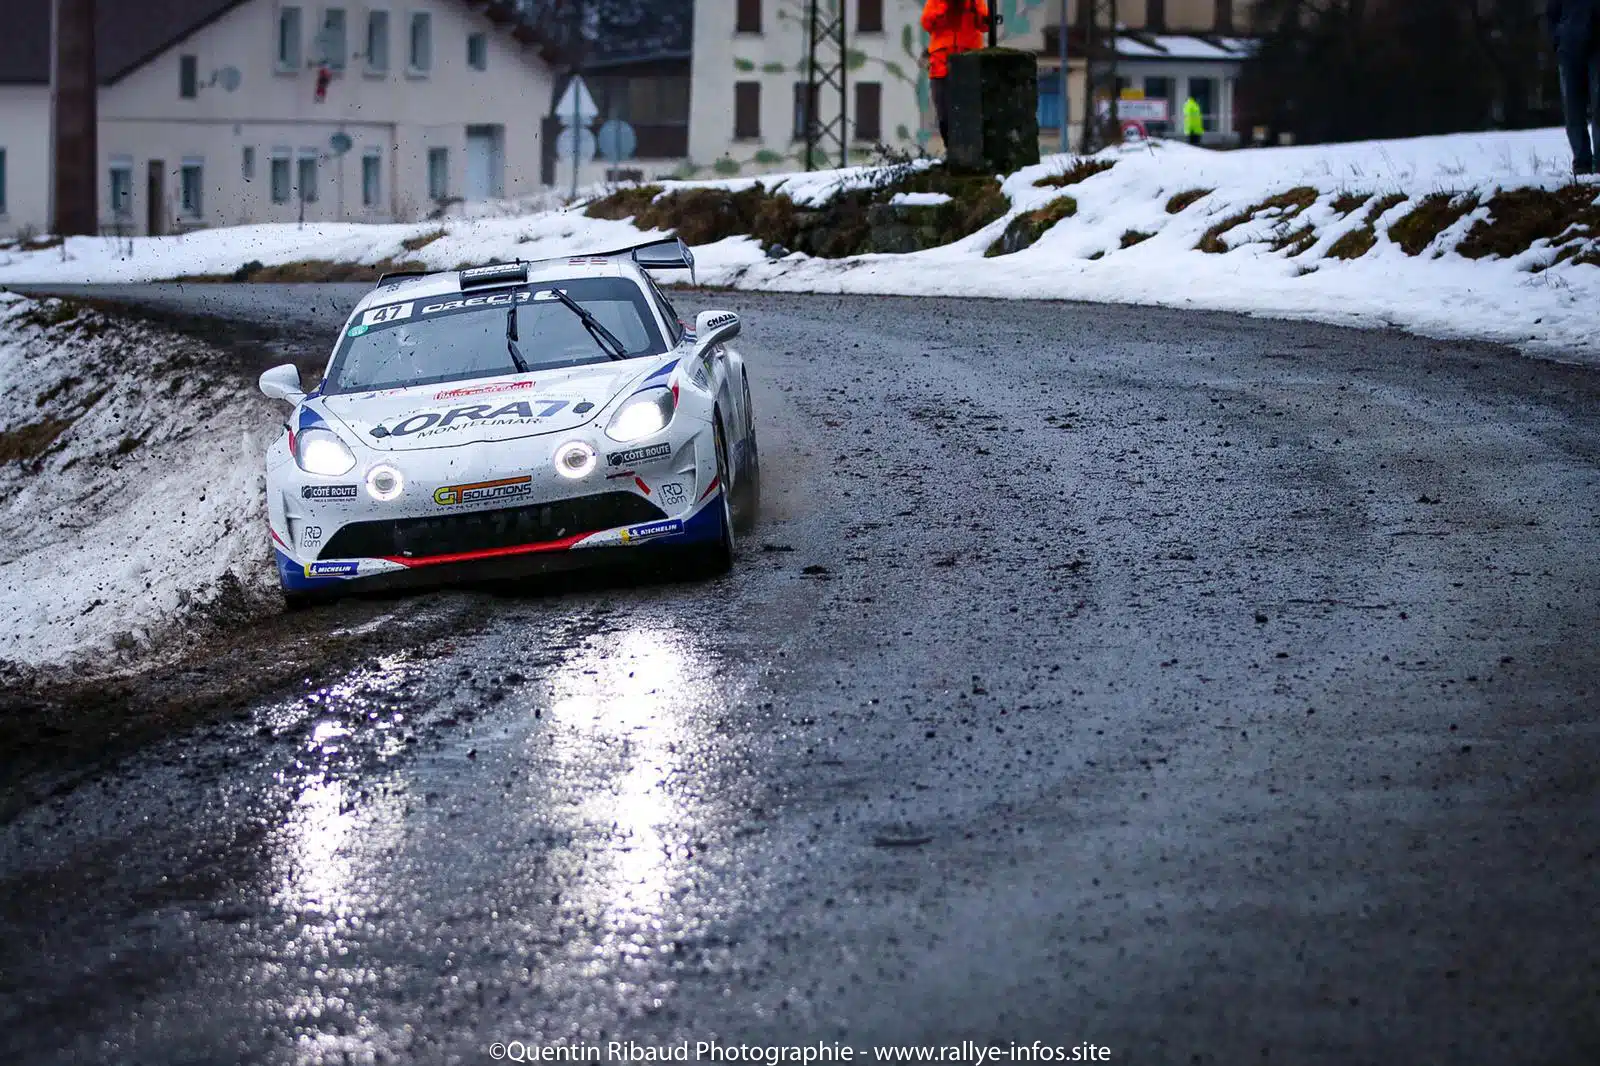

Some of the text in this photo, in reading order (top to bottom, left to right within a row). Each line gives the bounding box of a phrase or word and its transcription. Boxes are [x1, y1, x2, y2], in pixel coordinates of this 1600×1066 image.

[373, 305, 402, 321] 47
[390, 400, 570, 436] ORA7
[416, 418, 538, 438] MONTELIMAR
[645, 445, 670, 457] ROUTE
[313, 487, 356, 497] CÔTÉ ROUTE
[464, 483, 533, 500] SOLUTIONS
[661, 482, 683, 497] RD
[666, 495, 688, 505] com
[304, 526, 322, 539] RD
[640, 524, 677, 535] MICHELIN
[304, 540, 321, 548] com
[323, 565, 352, 573] MICHELIN
